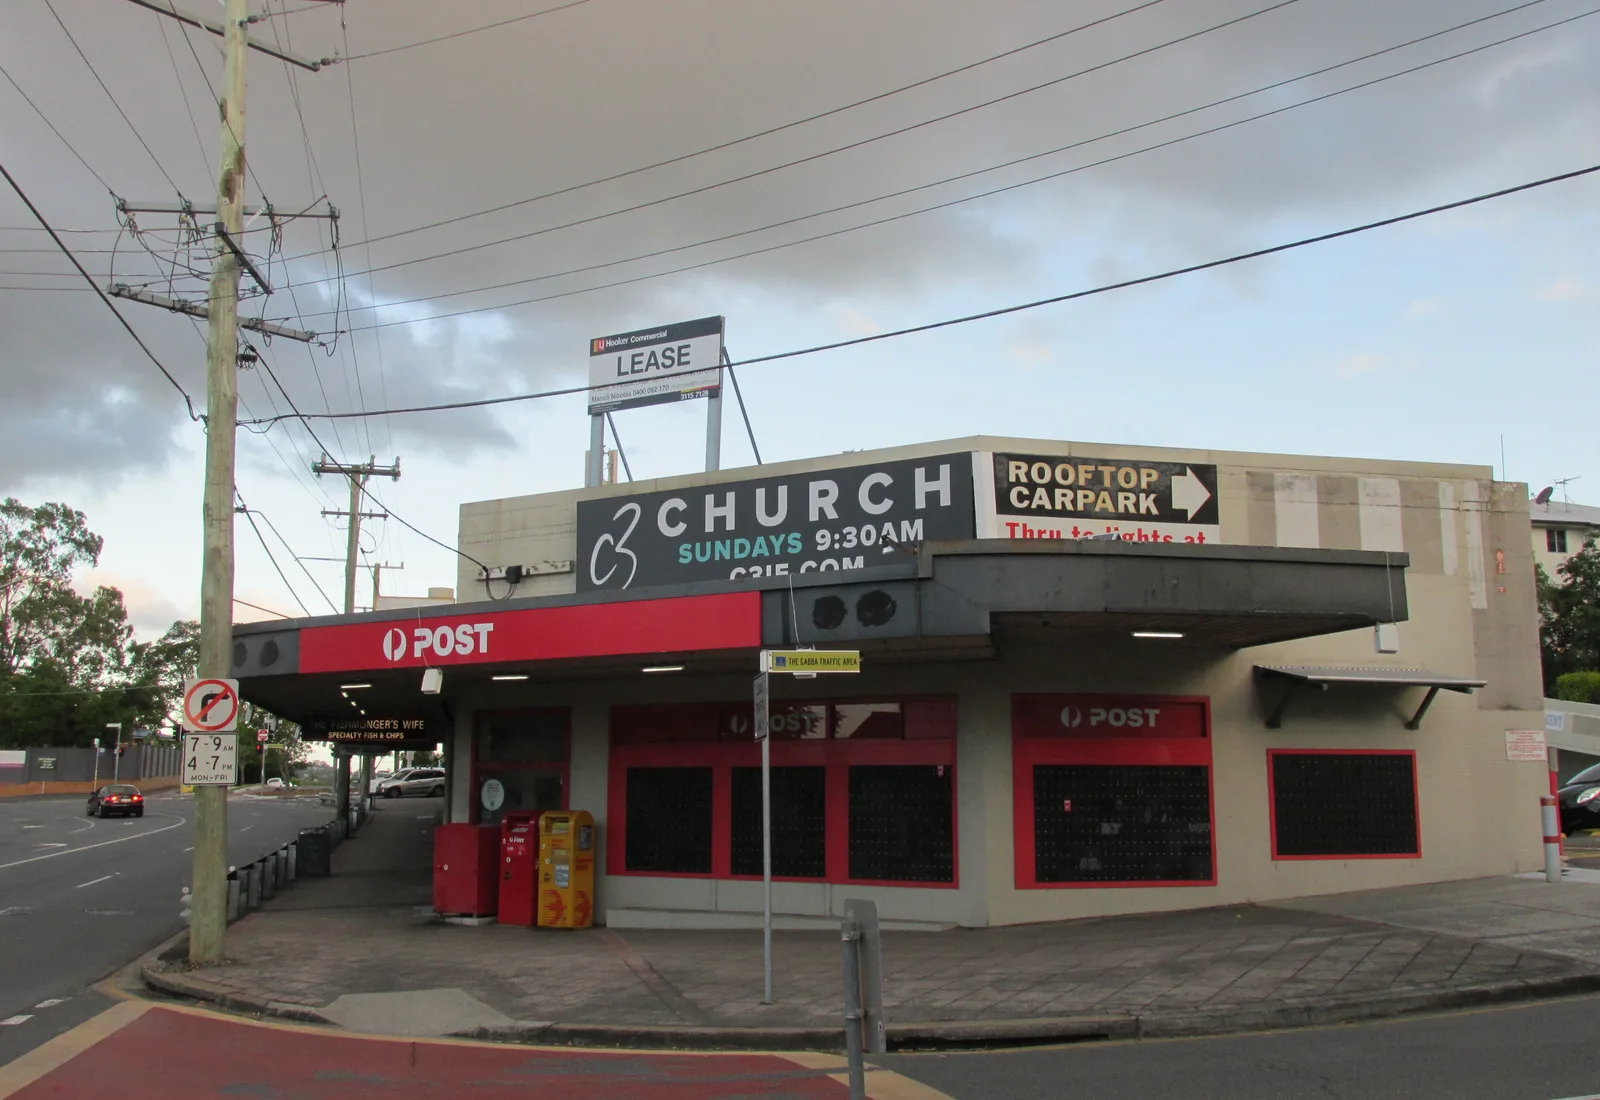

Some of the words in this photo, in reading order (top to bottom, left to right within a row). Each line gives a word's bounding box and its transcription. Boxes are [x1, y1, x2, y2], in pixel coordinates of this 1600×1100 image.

[605, 337, 629, 348] Hooker
[630, 329, 668, 343] Commercial
[617, 344, 691, 377] LEASE
[611, 390, 632, 399] Nicolas
[632, 388, 647, 396] 0400
[1008, 460, 1159, 489] ROOFTOP
[657, 463, 952, 538] CHURCH
[1009, 486, 1160, 516] CARPARK
[1005, 522, 1062, 539] Thru
[678, 532, 802, 564] SUNDAYS
[815, 518, 924, 552] 9:30AM
[414, 622, 494, 657] POST
[789, 657, 799, 666] THE
[800, 657, 819, 666] GABBA
[819, 657, 841, 666] TRAFFIC
[842, 657, 858, 666] AREA
[308, 720, 326, 729] THE
[330, 719, 399, 730] FISHMONGER'S
[402, 720, 425, 730] WIFE
[769, 712, 816, 732] OST
[1089, 708, 1161, 728] POST
[328, 731, 362, 739] SPECIALTY
